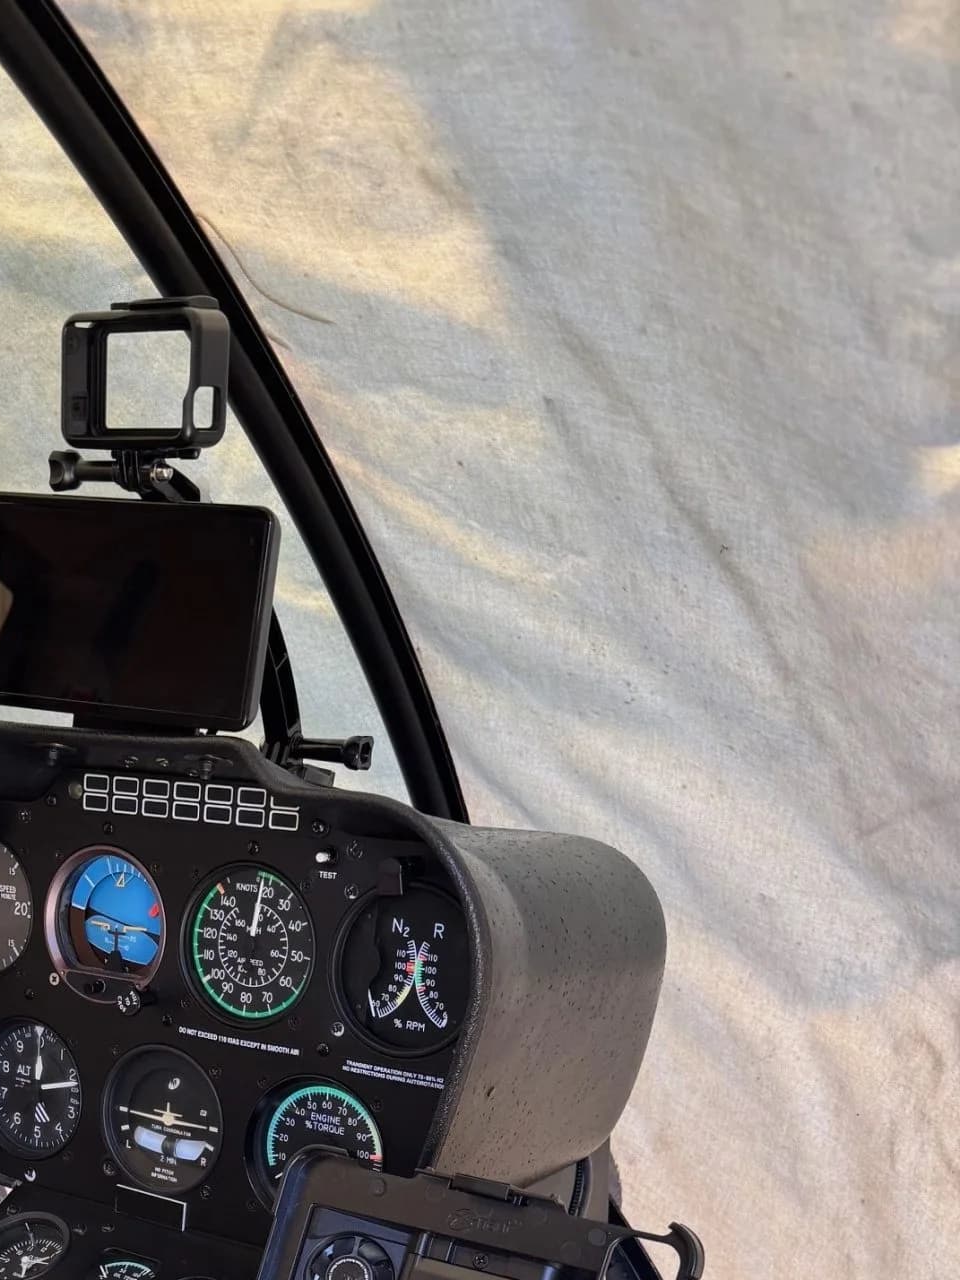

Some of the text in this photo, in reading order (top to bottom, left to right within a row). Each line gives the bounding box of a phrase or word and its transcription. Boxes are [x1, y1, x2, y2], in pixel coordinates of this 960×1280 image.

[319, 871, 338, 880] TEST
[0, 885, 17, 894] SPEED
[236, 883, 258, 893] KNOTS
[220, 896, 236, 907] 140
[277, 900, 291, 912] 30
[14, 901, 28, 916] 20
[210, 909, 225, 921] 130
[288, 920, 302, 932] 40
[434, 923, 445, 940] R
[203, 928, 218, 939] 120
[203, 949, 215, 961] 110
[290, 951, 304, 963] 50
[394, 961, 407, 970] 100
[425, 966, 437, 975] 100
[210, 968, 225, 980] 100
[393, 974, 404, 983] 90
[221, 982, 234, 994] 90
[279, 976, 292, 988] 60
[425, 979, 436, 988] 90
[388, 984, 397, 993] 80
[240, 992, 253, 1004] 80
[261, 992, 273, 1004] 70
[405, 1021, 426, 1032] RPM
[16, 1040, 24, 1053] 9
[187, 1028, 197, 1036] NOT
[197, 1030, 218, 1041] EXCEED
[240, 1039, 260, 1050] EXCEPT
[267, 1044, 290, 1054] SMOOTH
[2, 1060, 10, 1073] 8
[17, 1064, 32, 1076] ALT
[346, 1059, 373, 1071] TRANSIENT
[373, 1066, 402, 1076] OPERATION
[402, 1071, 417, 1079] ONLY
[69, 1068, 77, 1082] 2
[350, 1066, 386, 1079] RESTRICTIONS
[385, 1073, 406, 1083] DURING
[1, 1086, 9, 1099] 7
[307, 1101, 317, 1110] 50
[321, 1101, 333, 1110] 60
[337, 1107, 348, 1116] 70
[67, 1106, 76, 1119] 3
[295, 1107, 306, 1117] 40
[13, 1112, 22, 1125] 6
[285, 1118, 296, 1127] 30
[310, 1111, 341, 1126] ENGINE
[348, 1118, 358, 1127] 80
[33, 1125, 41, 1138] 5
[55, 1121, 63, 1134] 4
[305, 1120, 345, 1136] %TORQUE
[279, 1134, 289, 1143] 20
[356, 1132, 368, 1142] 90
[126, 1139, 132, 1149] L
[278, 1152, 286, 1161] 10
[356, 1150, 370, 1160] 100
[200, 1157, 207, 1167] R
